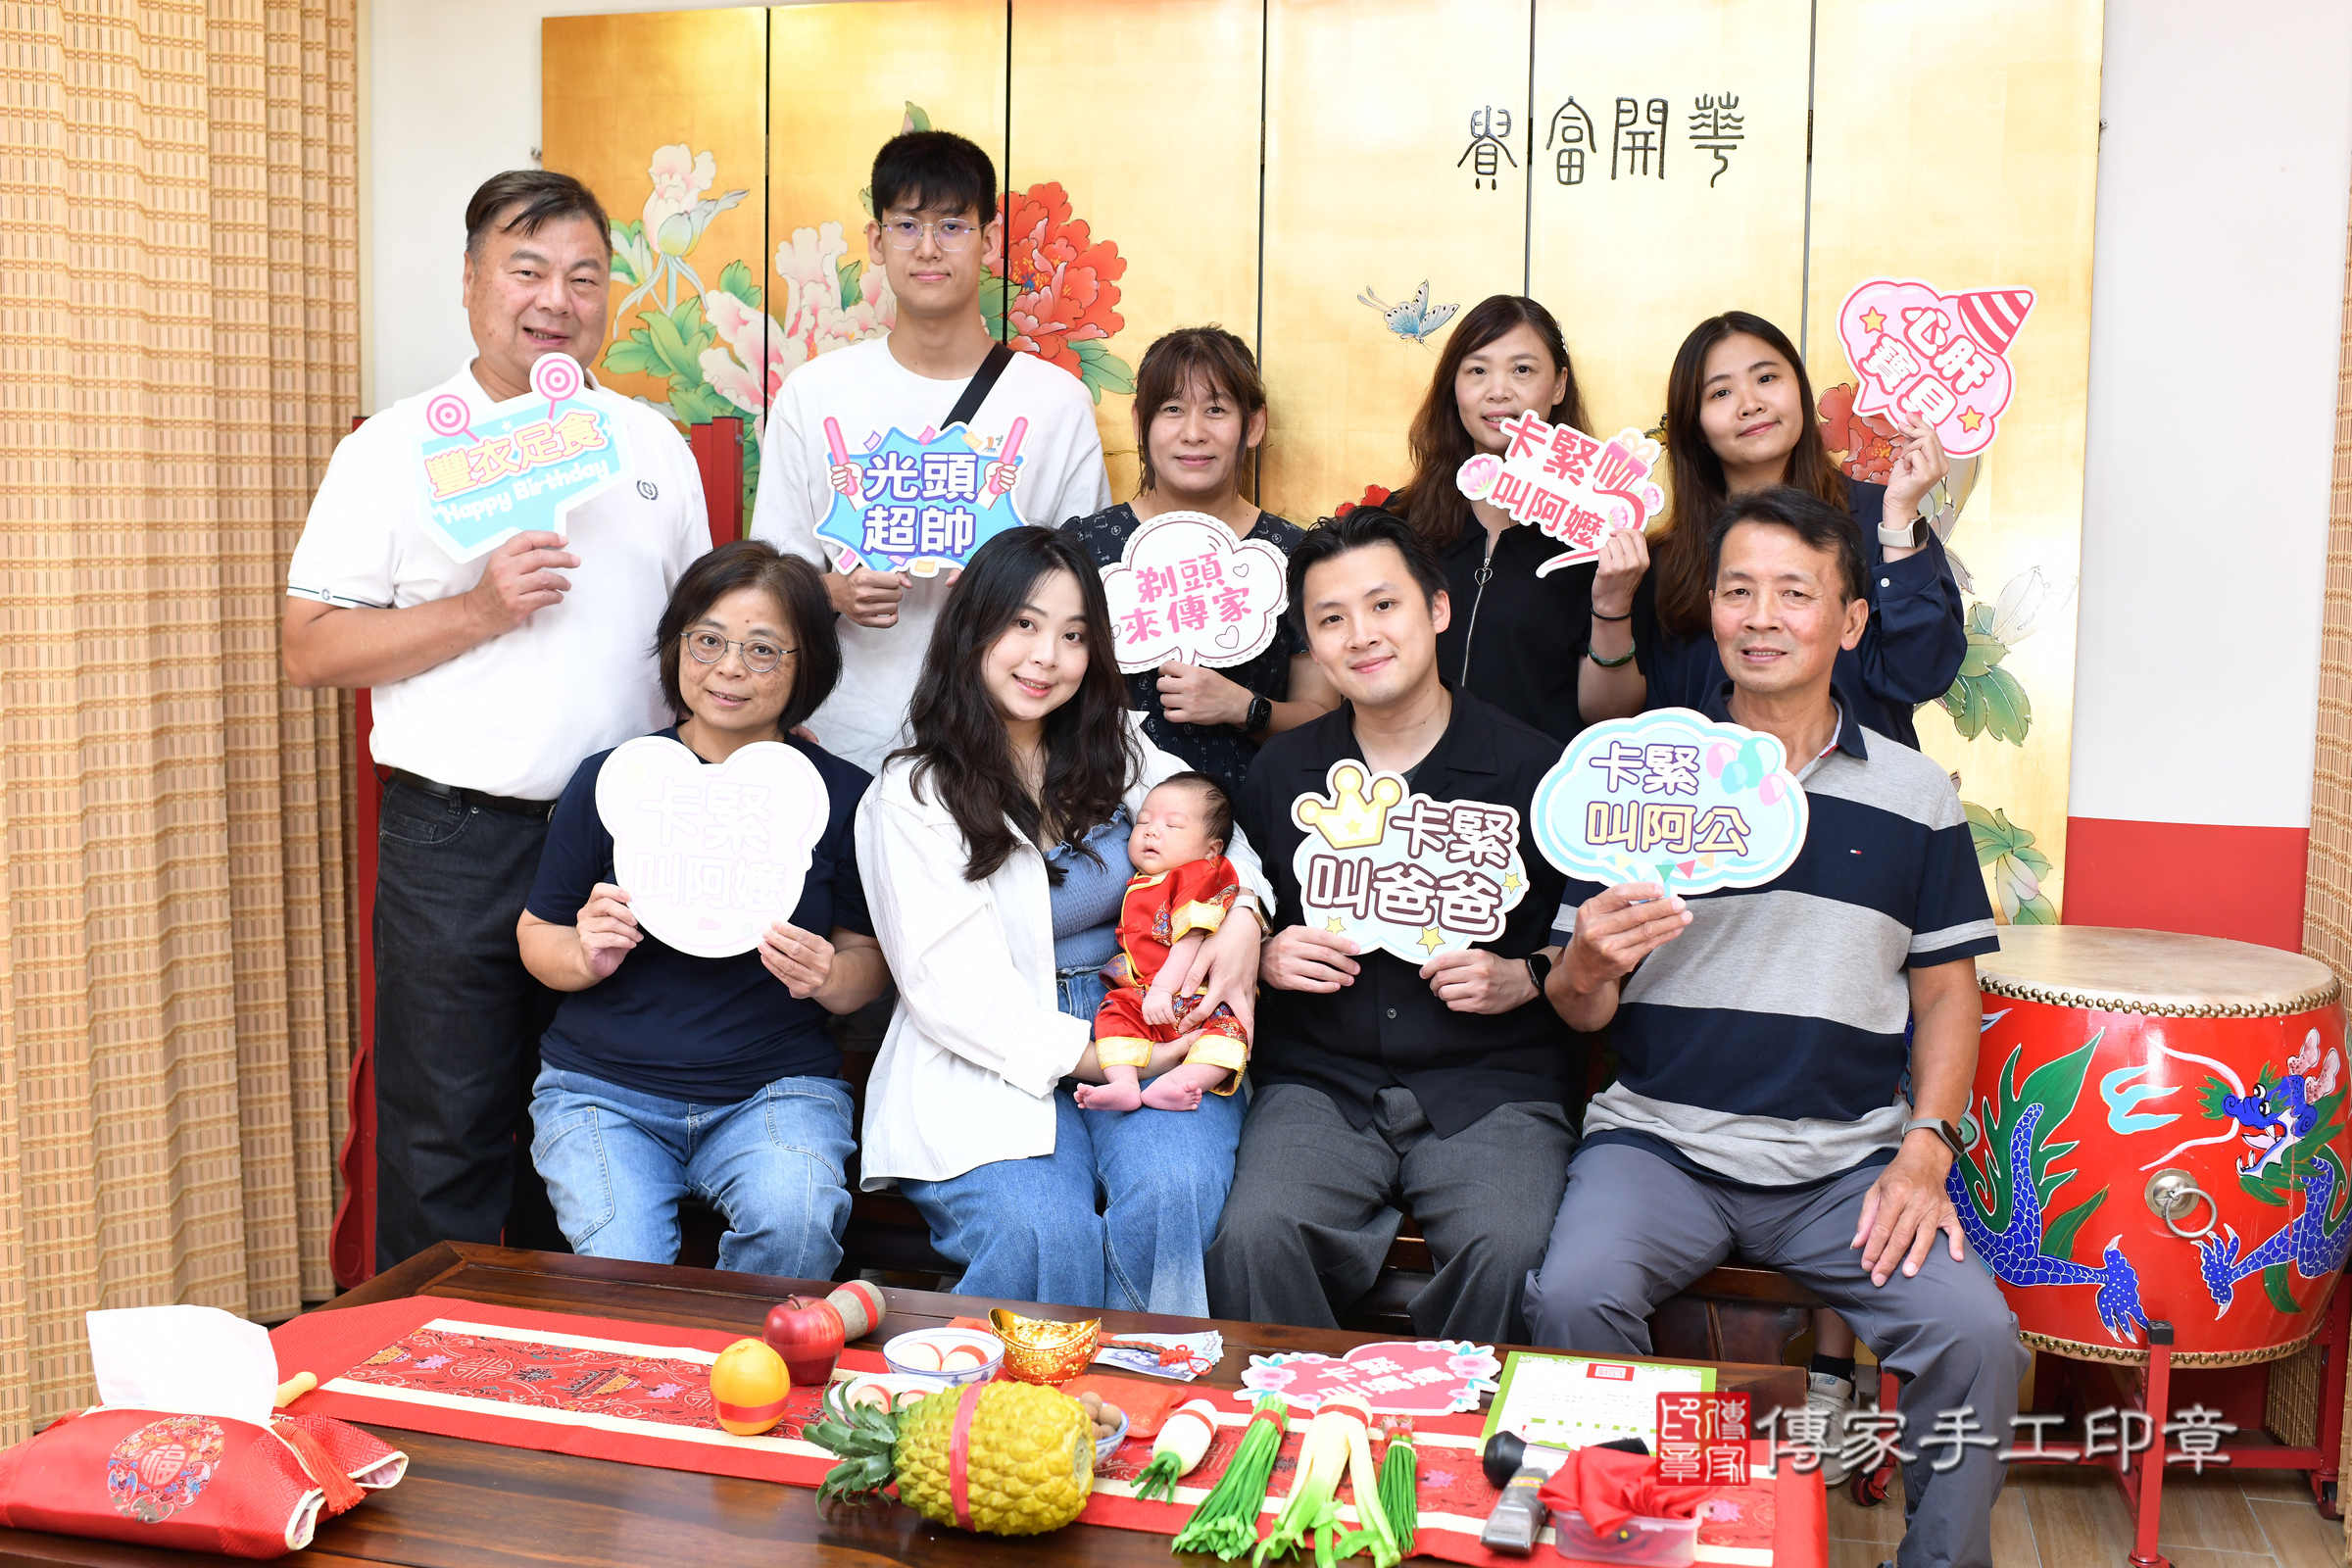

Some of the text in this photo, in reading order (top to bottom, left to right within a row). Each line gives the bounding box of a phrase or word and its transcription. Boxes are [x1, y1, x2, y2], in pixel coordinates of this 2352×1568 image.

[1858, 333, 1958, 429] 寶貝
[1901, 307, 1995, 396] 心肝
[424, 412, 605, 498] 豐衣足食
[862, 451, 979, 504] 光頭
[1504, 414, 1599, 486] 卡緊
[442, 460, 610, 525] Happy Birthday
[1492, 471, 1605, 549] 叫阿嬤
[860, 504, 976, 557] 超帥
[1136, 552, 1225, 603] 剃頭
[1120, 587, 1251, 645] 來傳家
[1590, 741, 1699, 796] 卡緊
[637, 776, 772, 854] 卡緊
[1389, 799, 1520, 869] 卡緊
[1585, 802, 1750, 857] 叫阿公
[1308, 855, 1502, 937] 叫爸爸
[141, 1444, 186, 1487] 福
